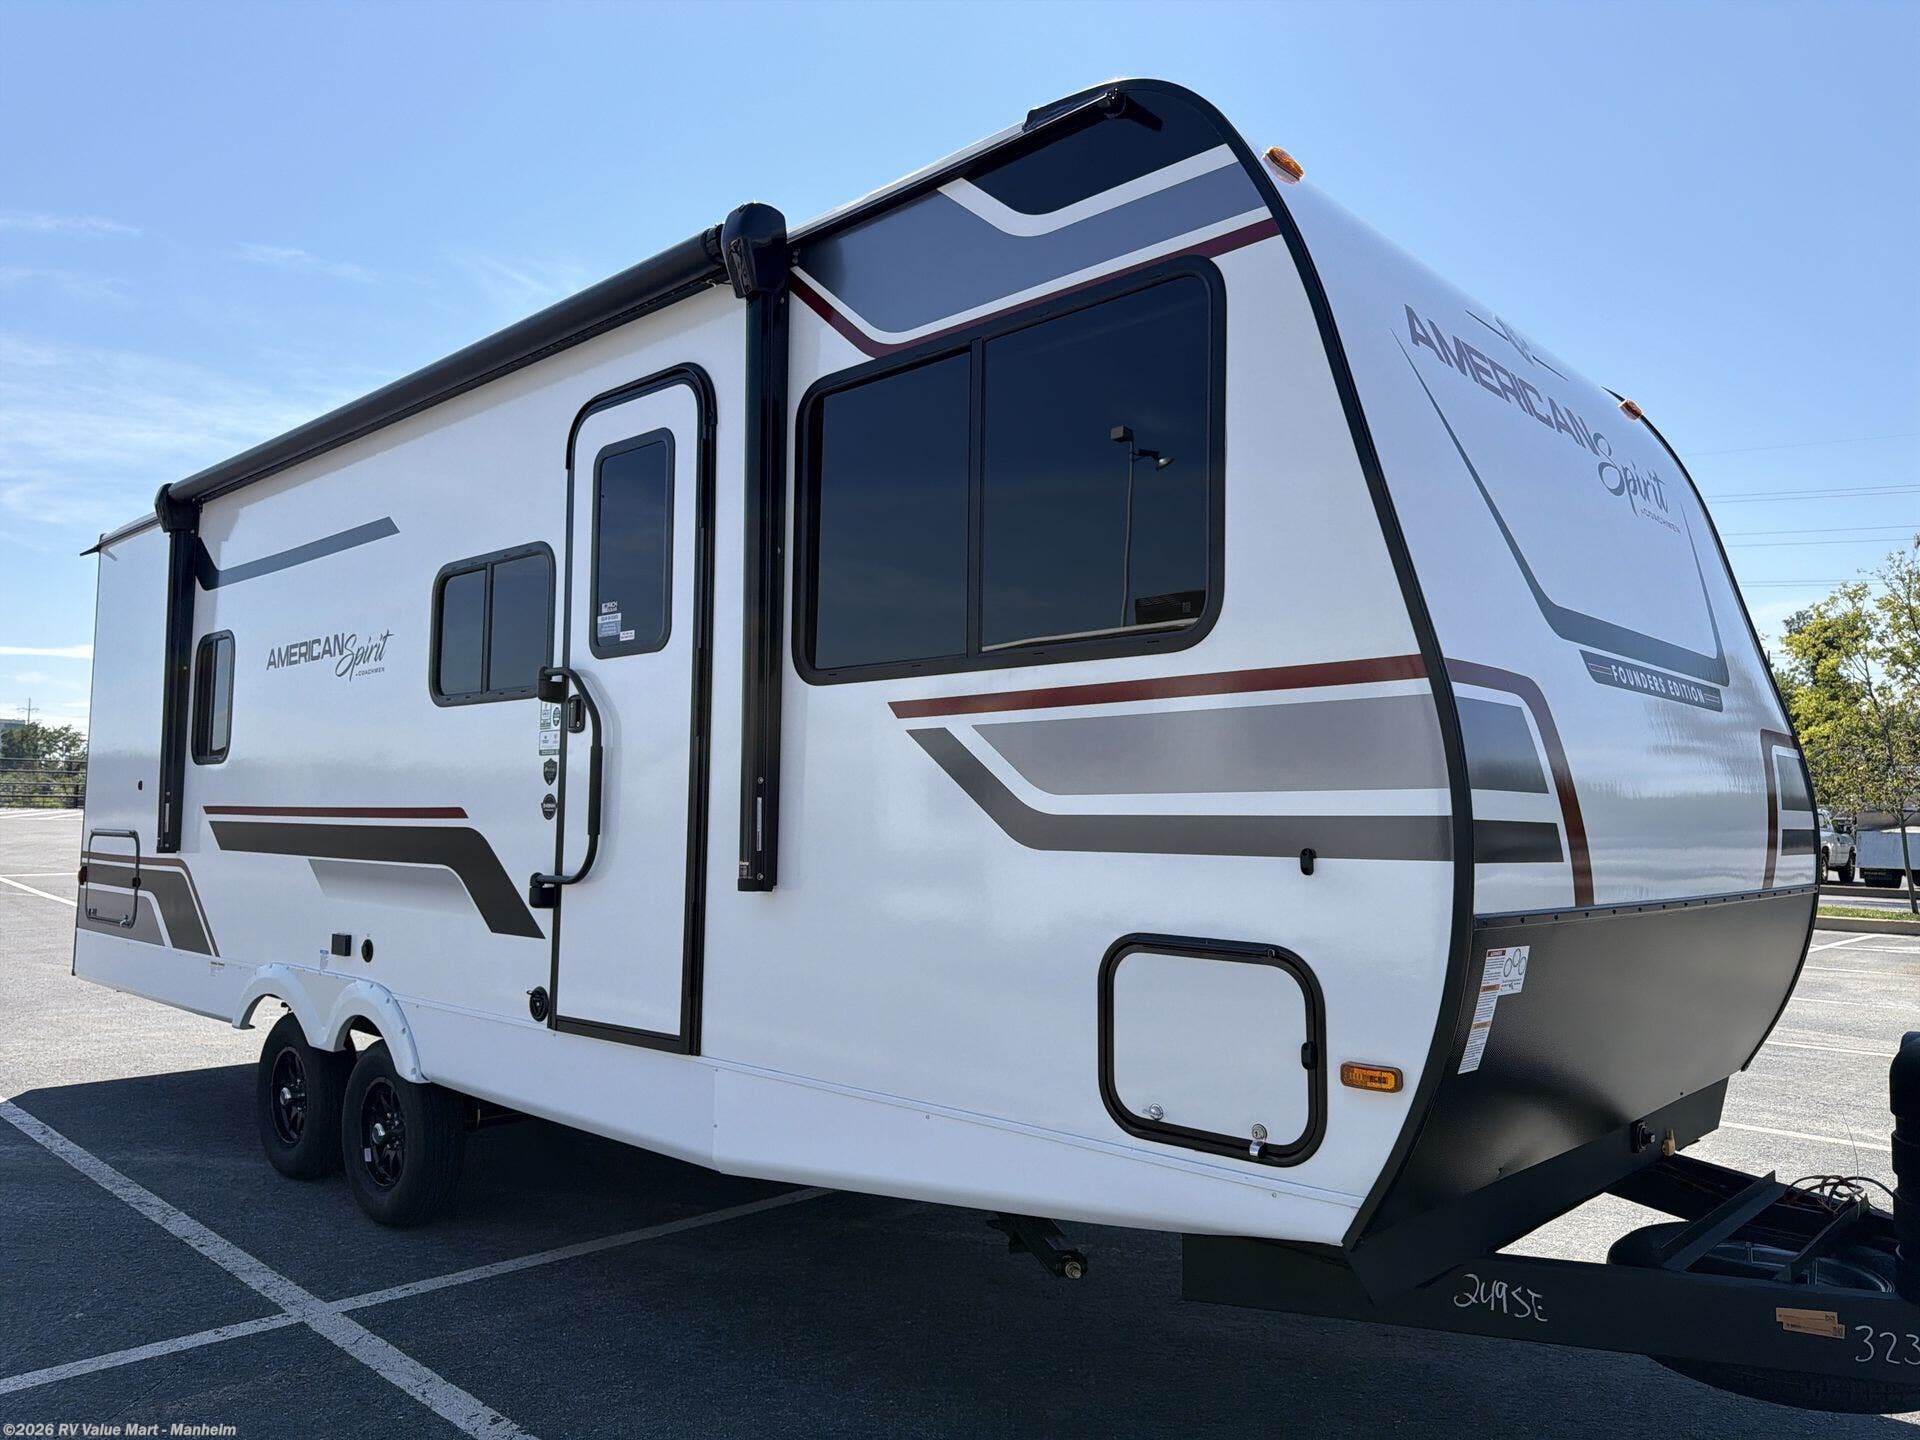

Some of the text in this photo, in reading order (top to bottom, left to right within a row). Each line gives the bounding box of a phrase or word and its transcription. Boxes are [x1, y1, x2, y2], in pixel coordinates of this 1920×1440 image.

[1404, 303, 1670, 517] AMERICAN Spirit
[266, 627, 395, 682] AMERICAN Spirit
[1611, 664, 1706, 704] FOUNDERS EDITION
